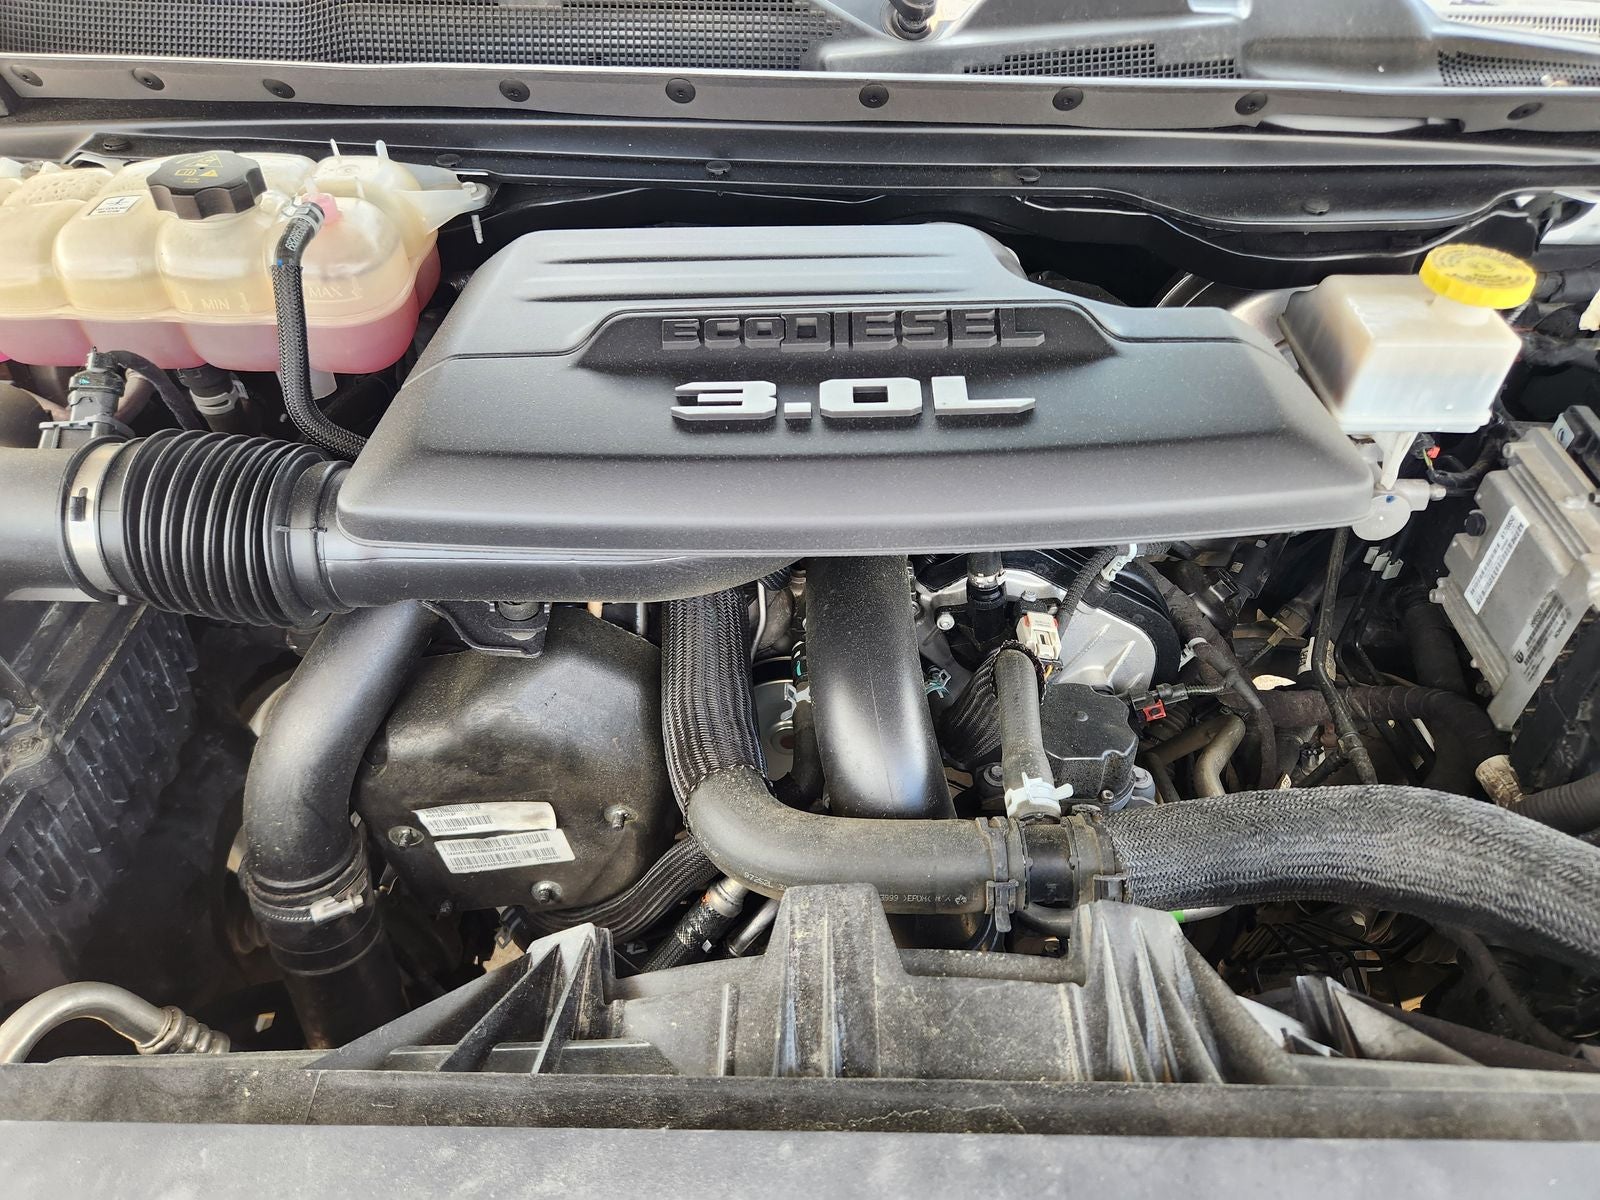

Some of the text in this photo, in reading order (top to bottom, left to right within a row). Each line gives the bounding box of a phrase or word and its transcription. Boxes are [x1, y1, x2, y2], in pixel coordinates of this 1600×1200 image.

[202, 296, 230, 310] MIN
[308, 286, 343, 298] MAX
[662, 308, 1045, 352] ECODIESEL
[670, 375, 1036, 420] 3.0L
